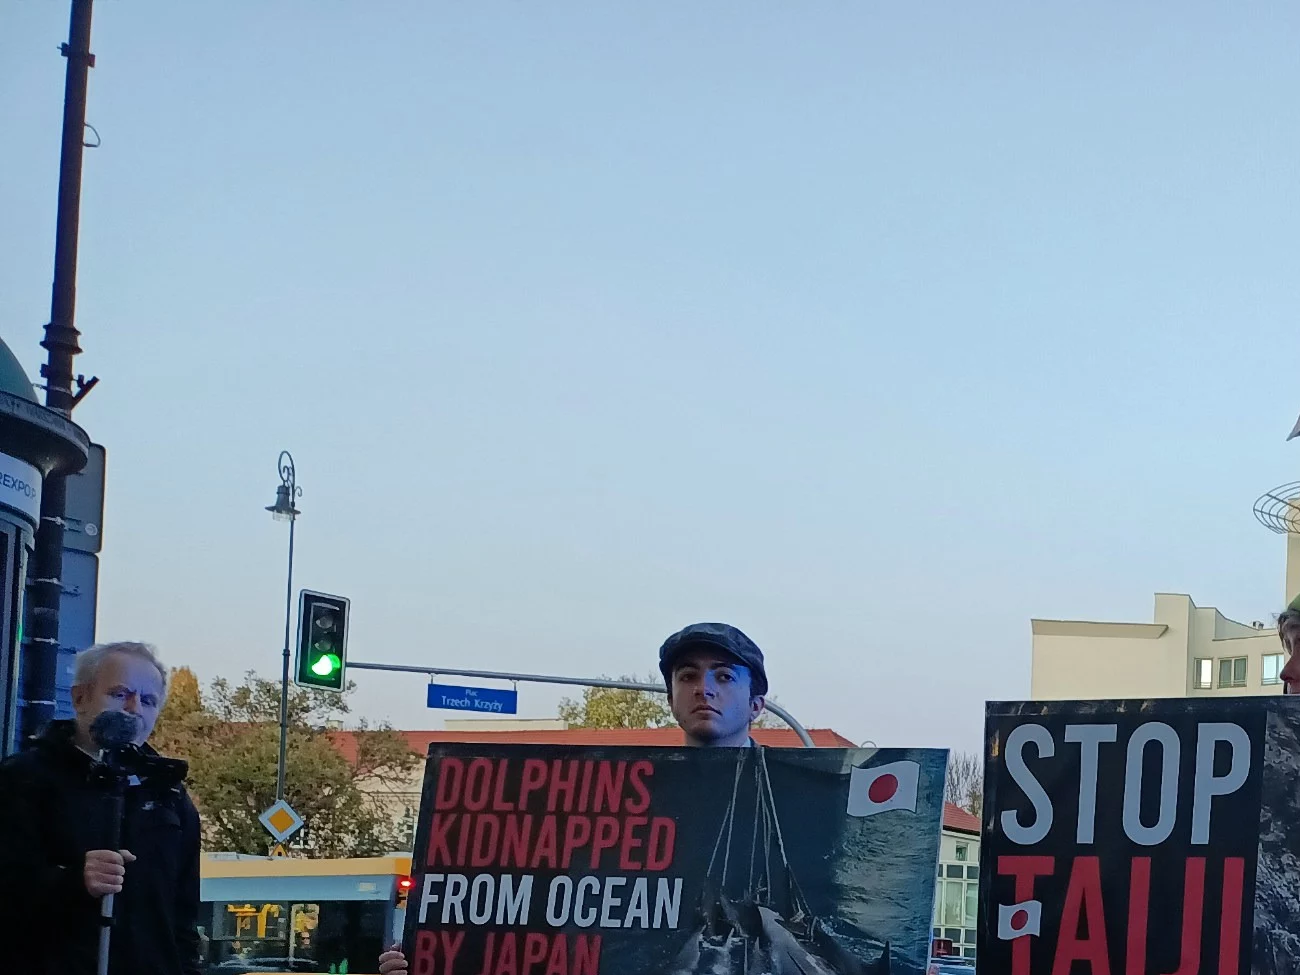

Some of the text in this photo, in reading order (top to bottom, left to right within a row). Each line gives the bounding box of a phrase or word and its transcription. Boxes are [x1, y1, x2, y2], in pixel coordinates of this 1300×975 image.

[441, 696, 503, 711] Trzech Krzyży
[435, 758, 655, 814] DOLPHINS
[1001, 722, 1251, 845] STOP
[426, 813, 676, 871] KIDNAPPED
[418, 874, 683, 929] FROM OCEAN
